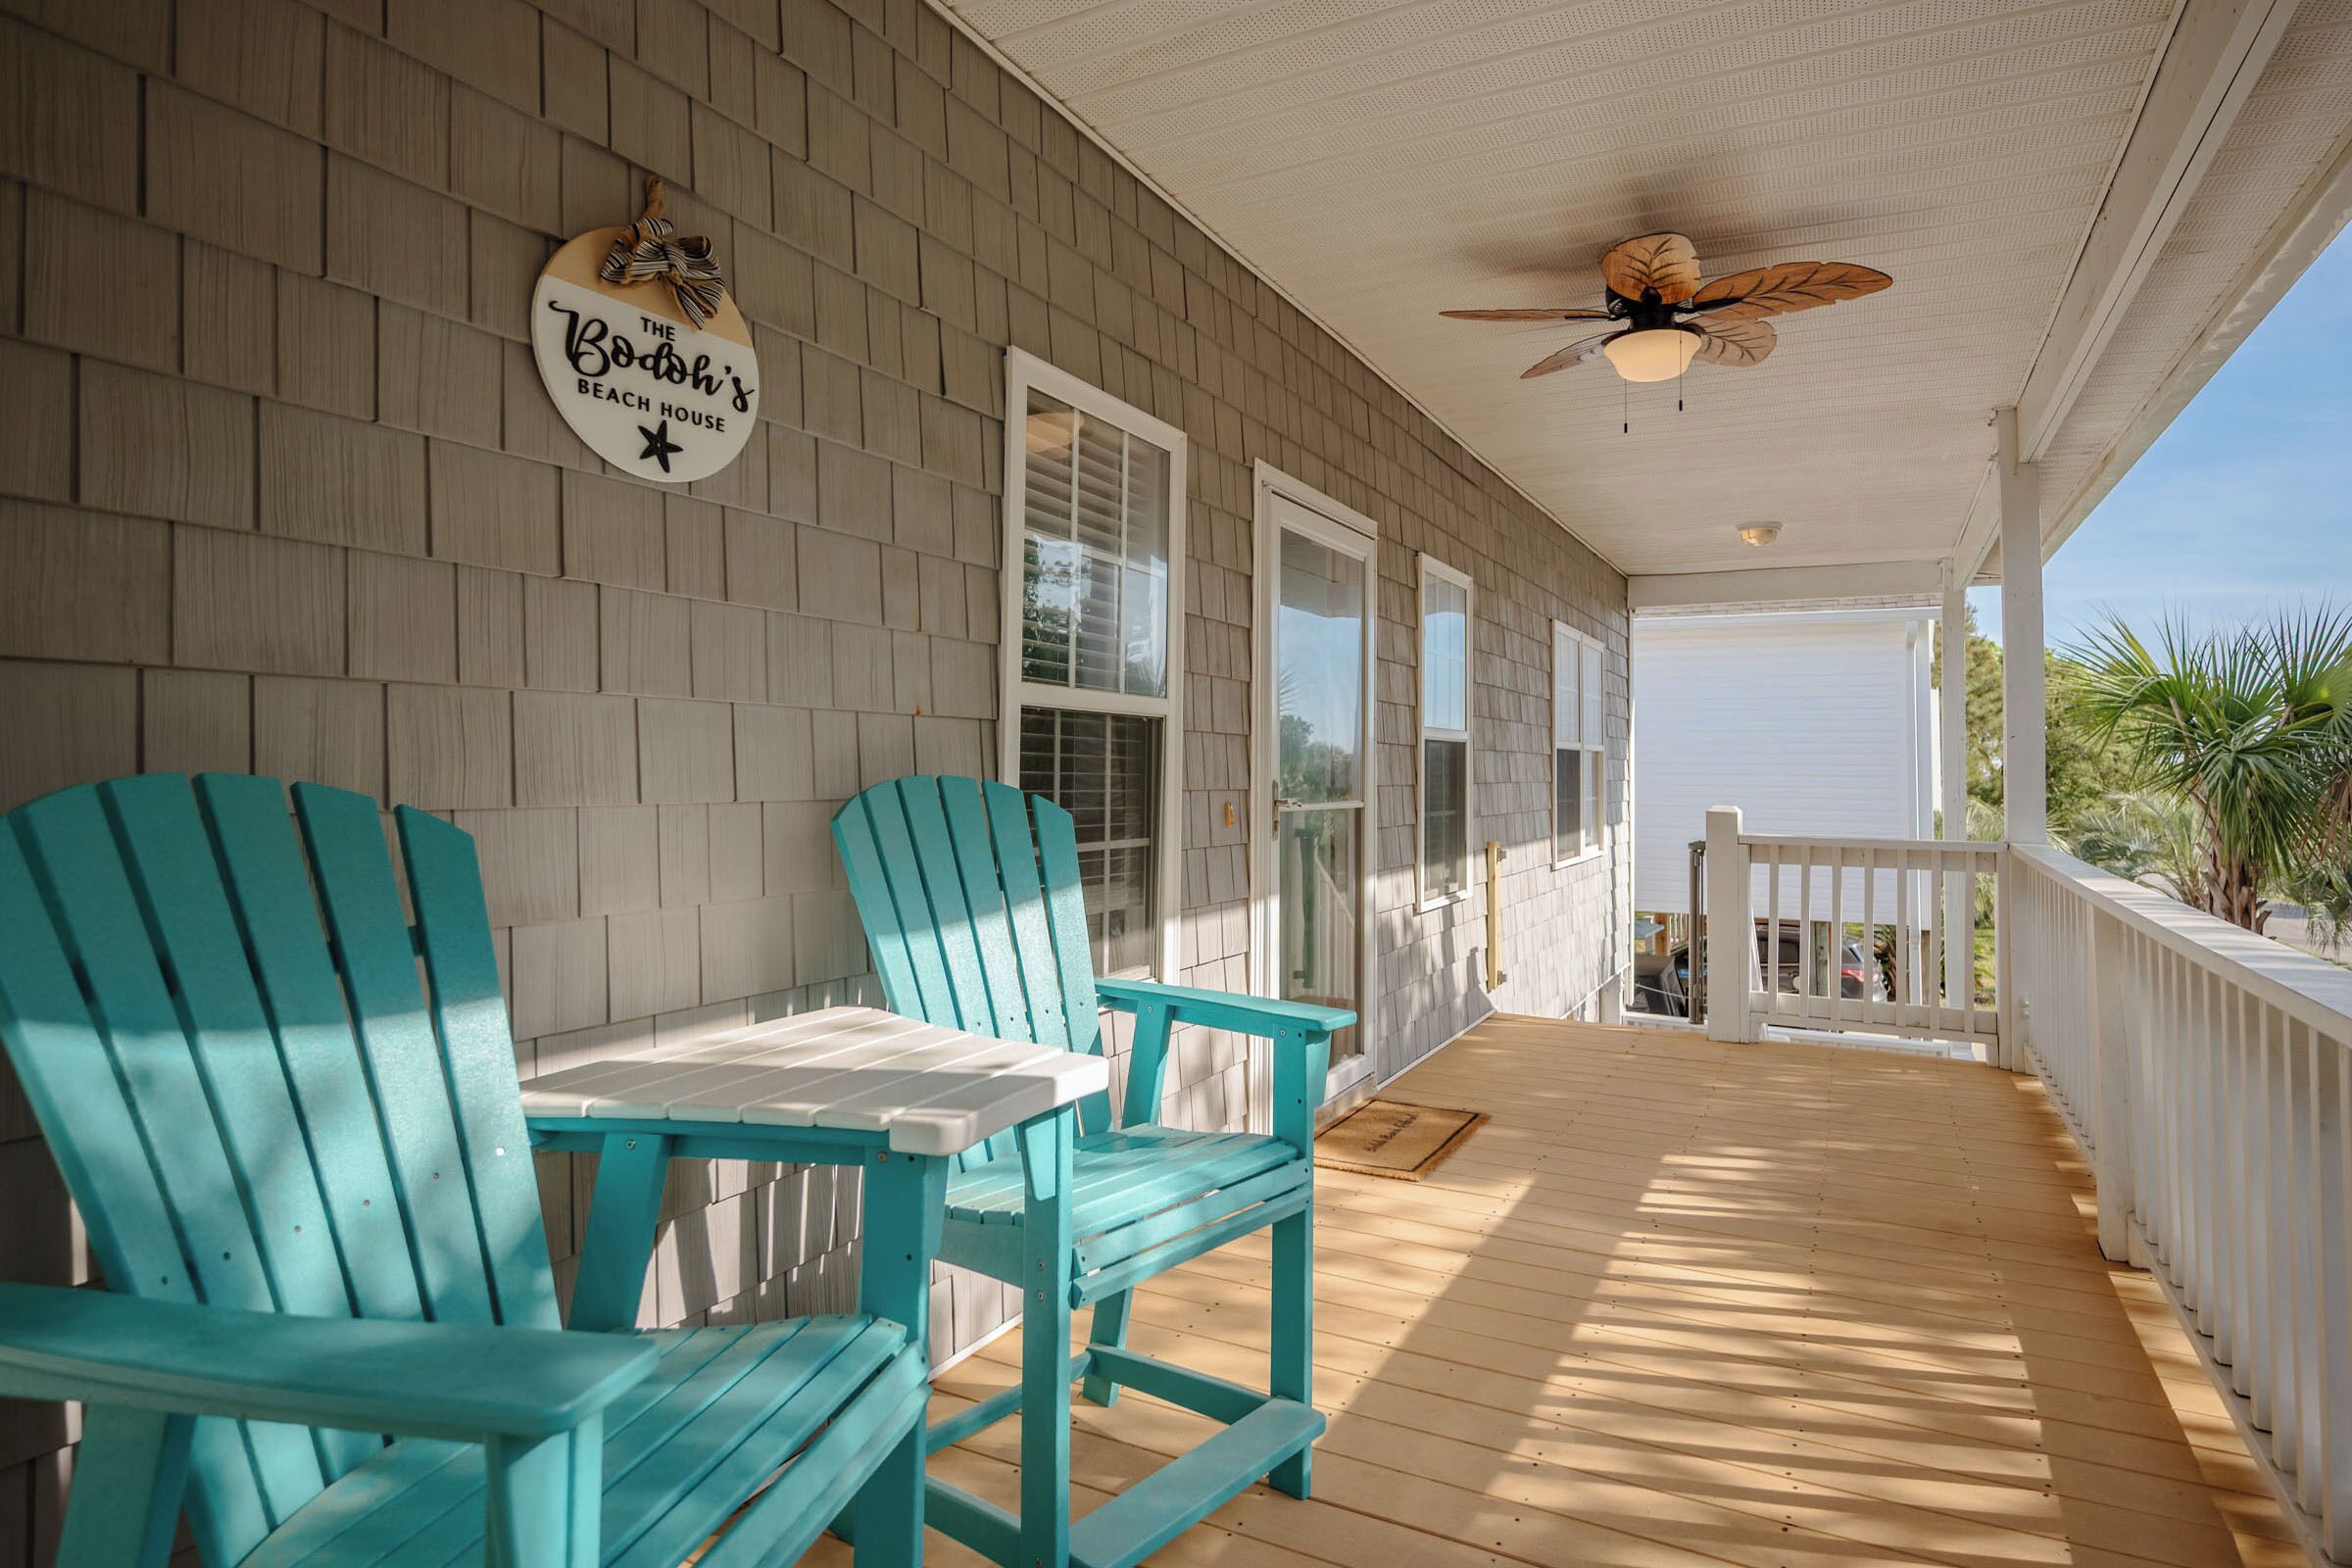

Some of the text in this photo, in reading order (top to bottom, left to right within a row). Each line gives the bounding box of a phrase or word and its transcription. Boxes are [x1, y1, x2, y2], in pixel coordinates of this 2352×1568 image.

[640, 317, 675, 341] THE
[548, 300, 756, 413] Bodoh's
[577, 378, 726, 432] BEACH HOUSE
